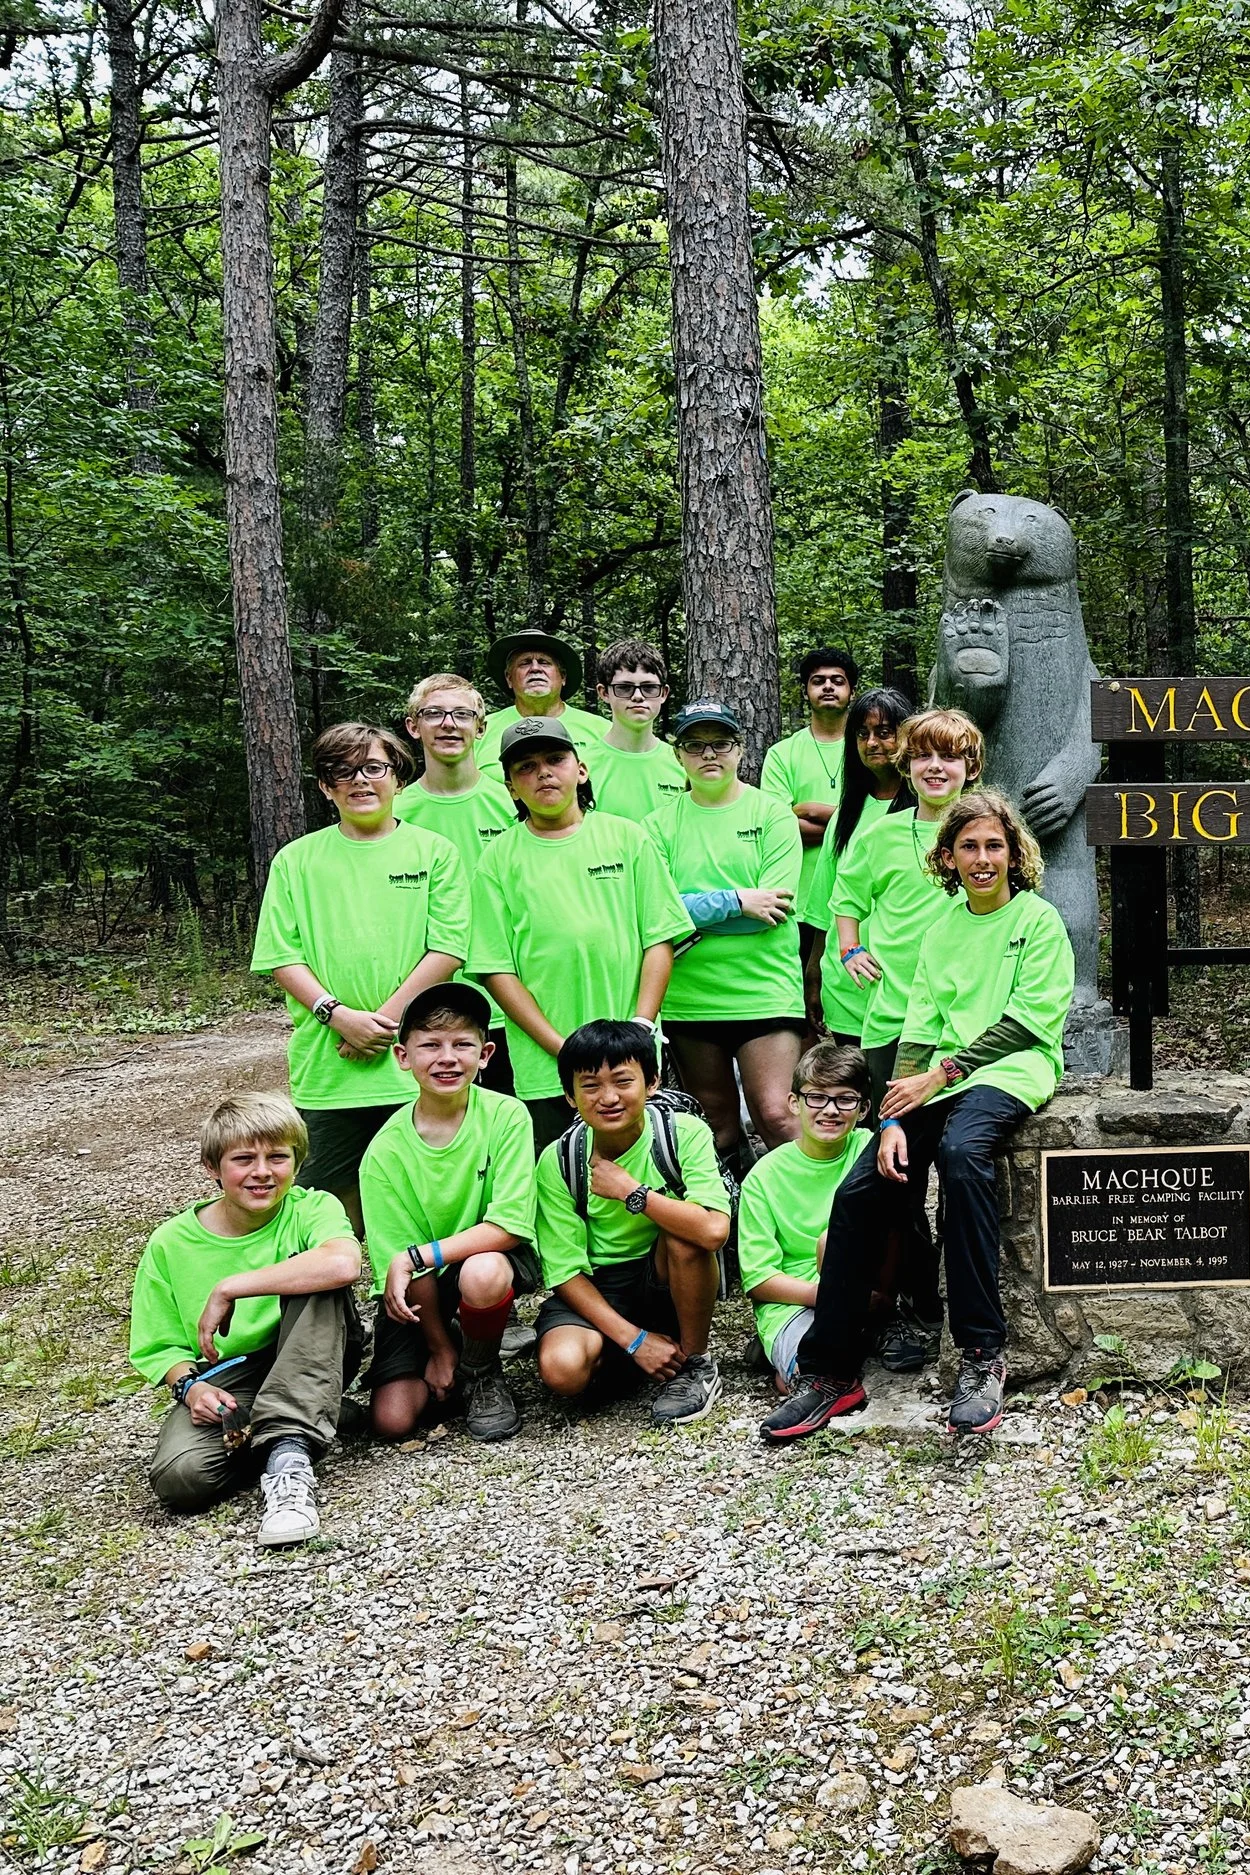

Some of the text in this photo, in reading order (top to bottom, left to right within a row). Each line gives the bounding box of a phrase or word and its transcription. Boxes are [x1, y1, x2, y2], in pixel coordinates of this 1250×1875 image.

[1118, 790, 1243, 841] BIG
[1082, 1167, 1214, 1191] MACHQUE
[1052, 1191, 1245, 1206] BARRIER FREE CAMPING FACILITY
[1112, 1214, 1186, 1225] IN MEMORY OF
[1071, 1230, 1118, 1243] BRUCE
[1174, 1226, 1228, 1240] TALBOT
[1071, 1261, 1090, 1270] MAY
[1095, 1261, 1106, 1270] 12,
[1109, 1260, 1128, 1269] 1927
[1140, 1258, 1192, 1268] NOVEMBER
[1208, 1256, 1228, 1266] 1995
